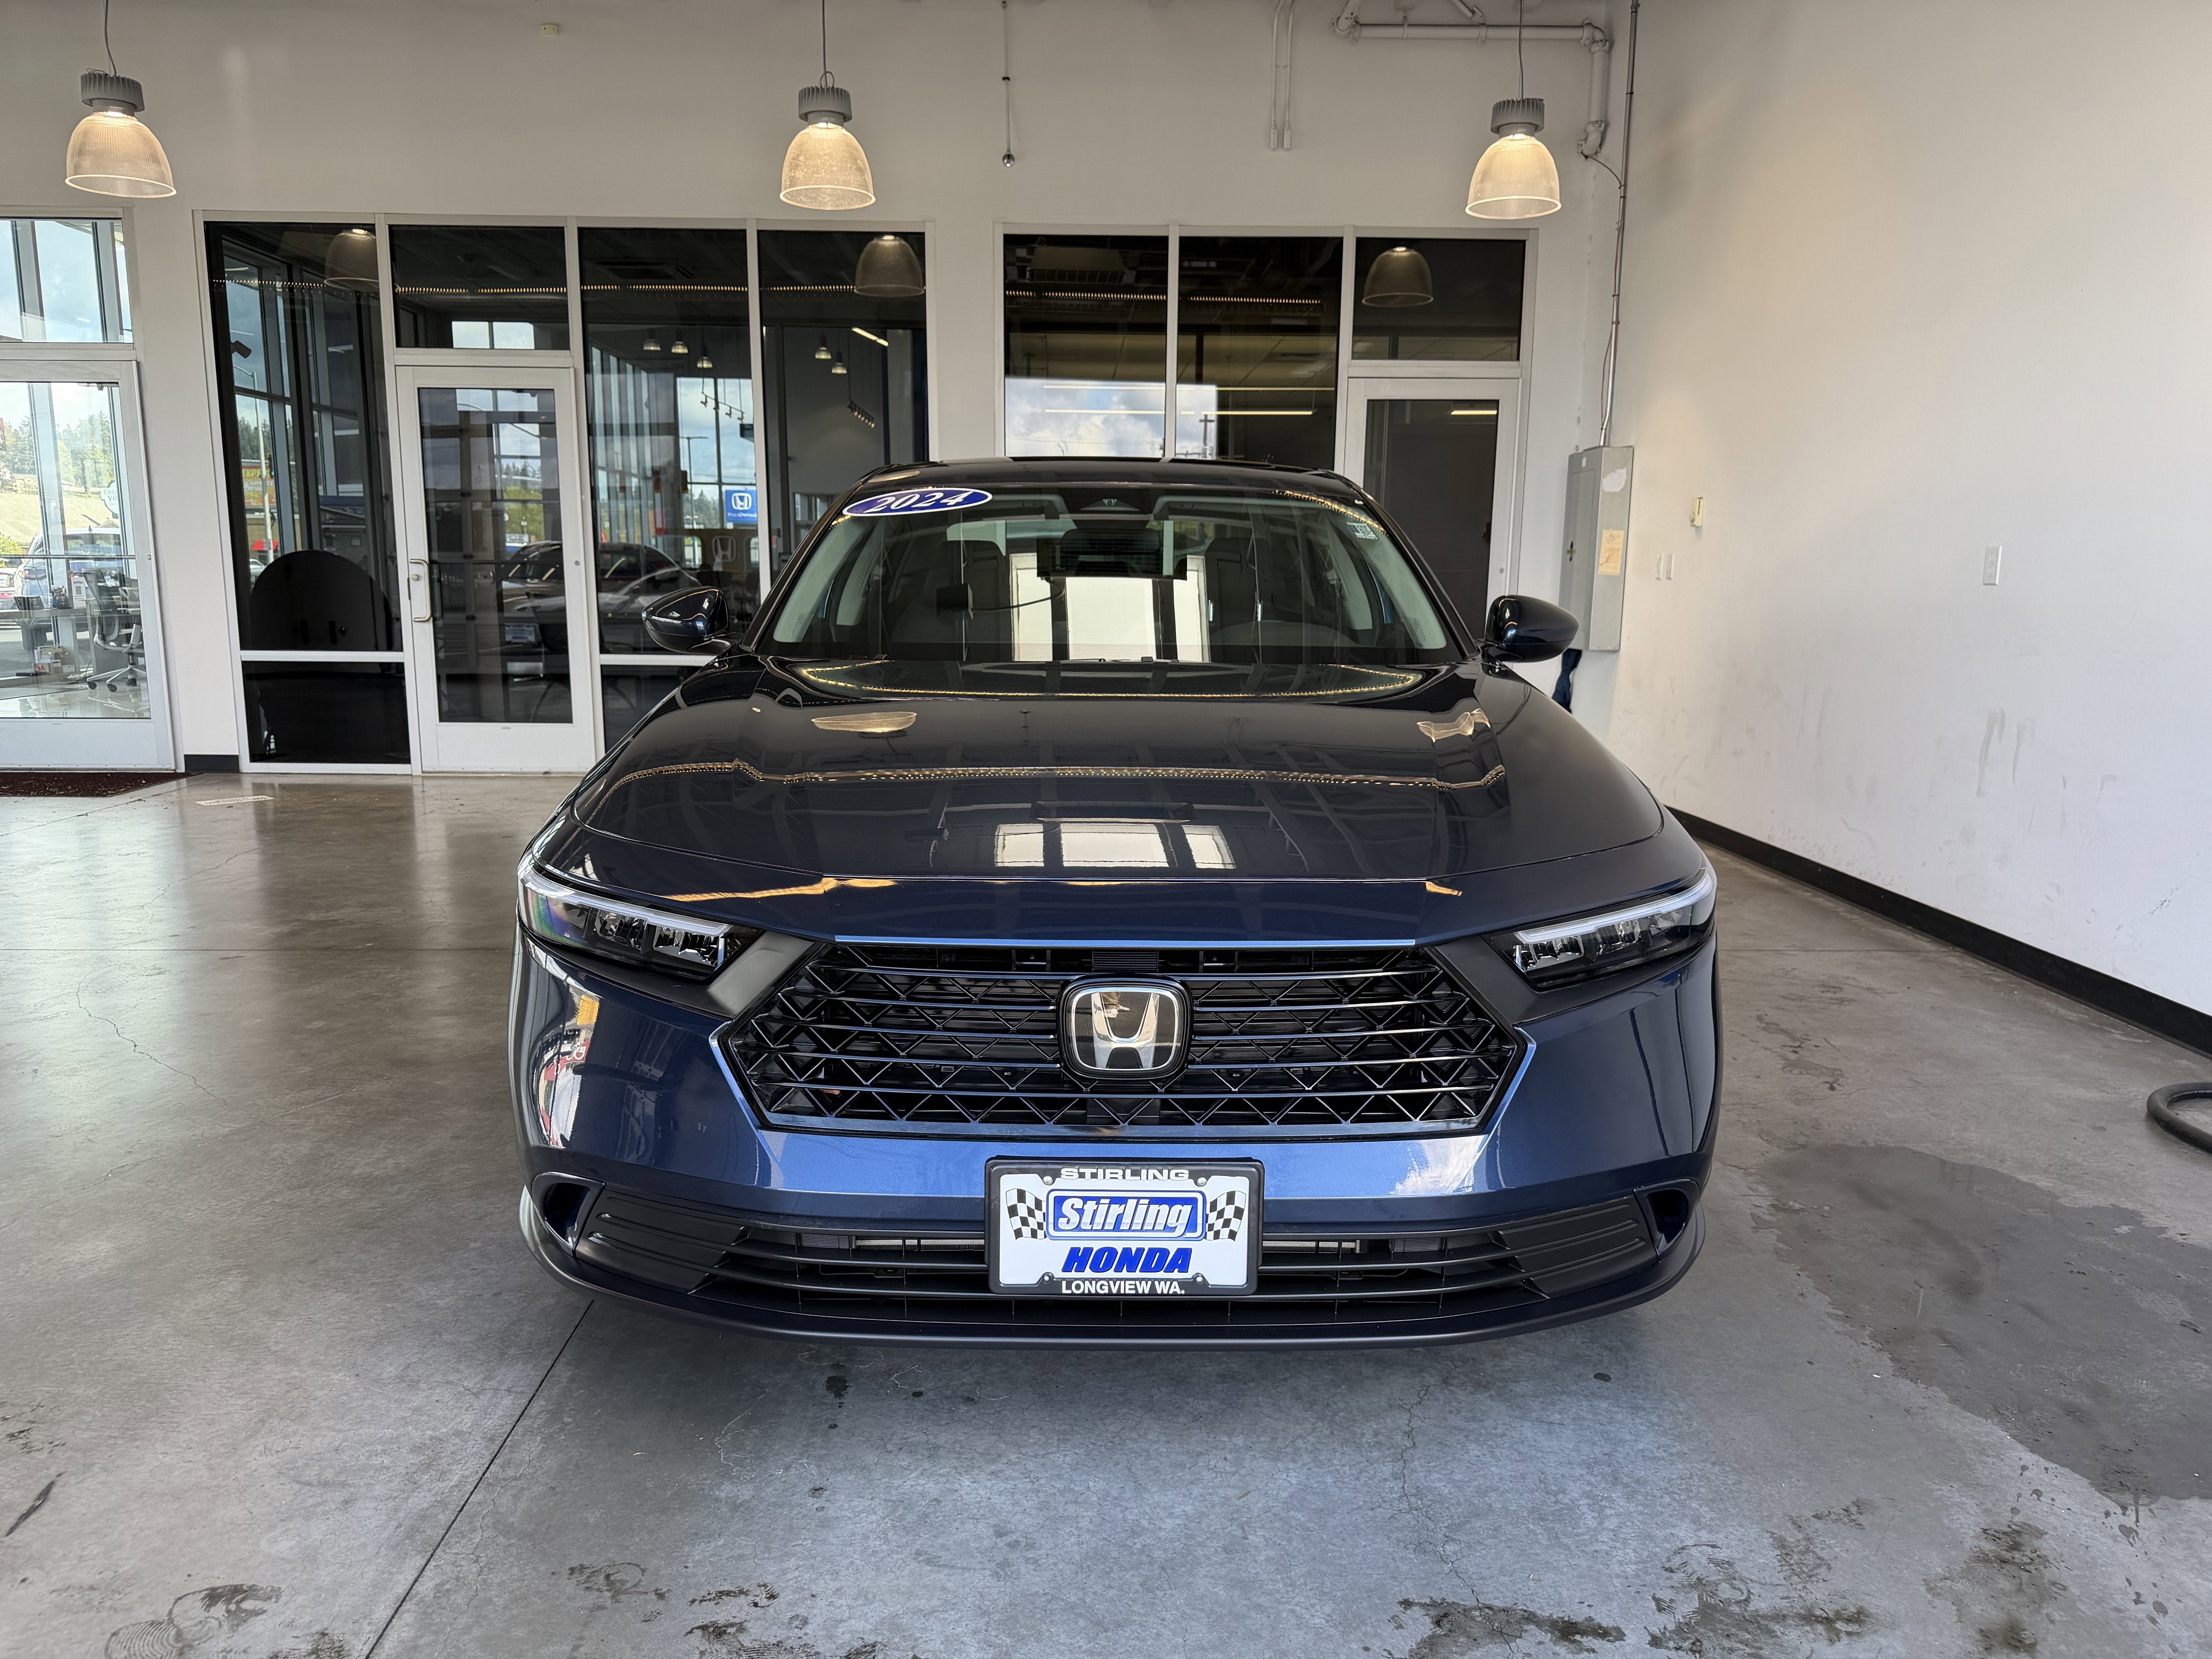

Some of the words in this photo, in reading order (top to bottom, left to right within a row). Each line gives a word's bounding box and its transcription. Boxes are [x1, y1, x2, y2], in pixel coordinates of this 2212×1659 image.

[863, 491, 974, 513] 2024
[1060, 1168, 1189, 1180] STIRLING
[1057, 1197, 1193, 1238] Stirling
[1061, 1247, 1192, 1273] HONDA
[1061, 1281, 1153, 1294] LONGVIEW
[1154, 1281, 1185, 1294] WA.
